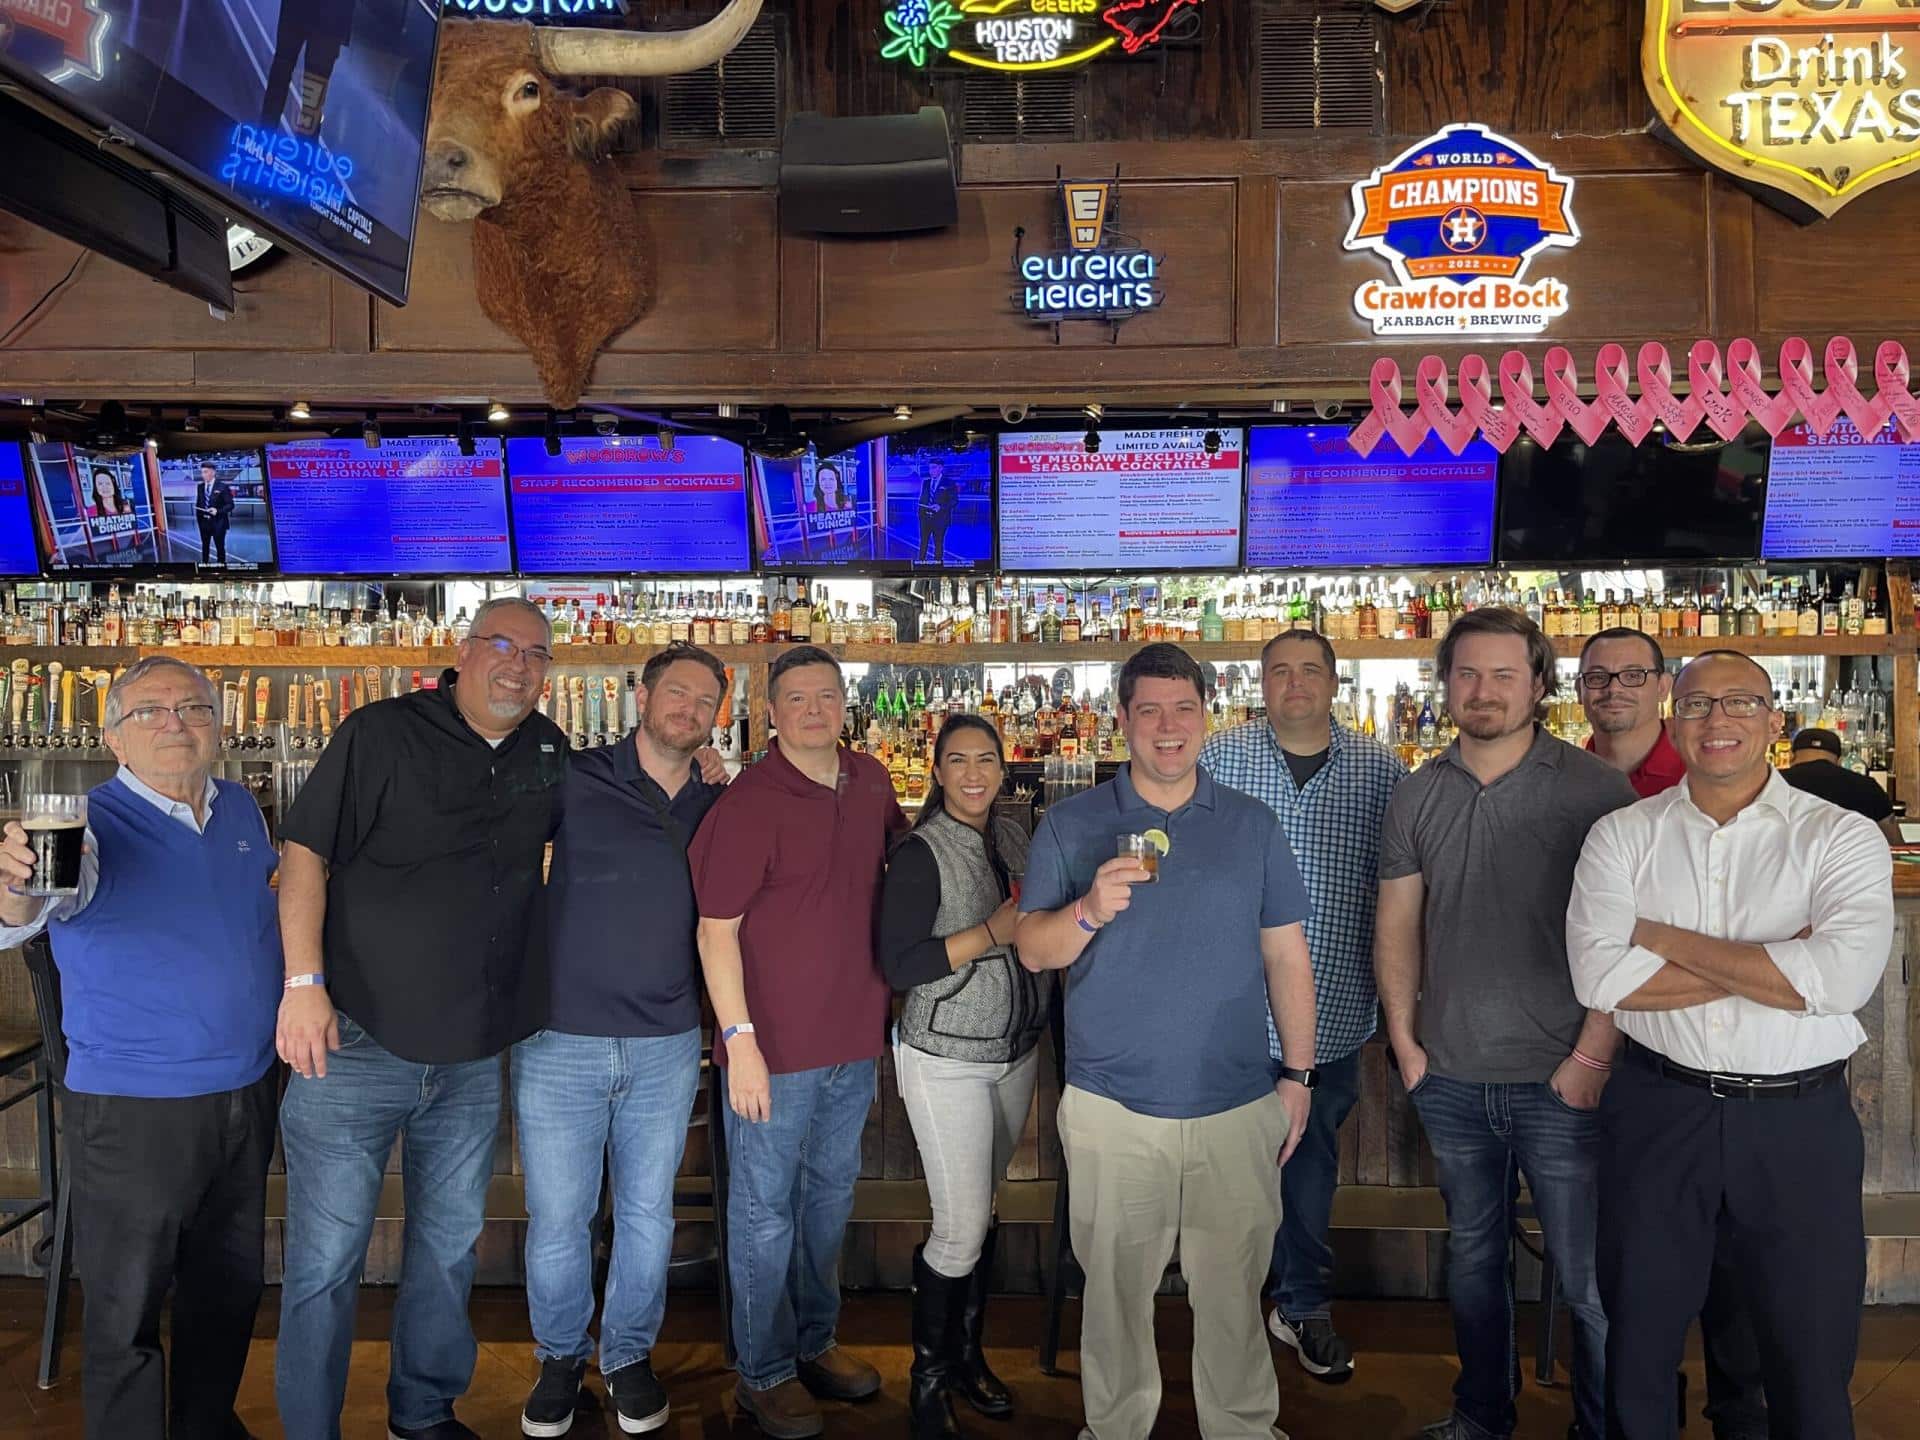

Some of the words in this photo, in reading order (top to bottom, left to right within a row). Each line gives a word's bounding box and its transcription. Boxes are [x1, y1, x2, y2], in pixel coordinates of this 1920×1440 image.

[976, 18, 1073, 44] HOUSTON
[994, 39, 1059, 62] TEXAS
[1747, 32, 1907, 85] Drink
[1725, 89, 1920, 142] TEXAS
[1436, 153, 1493, 165] WORLD
[1389, 177, 1538, 209] CHAMPIONS
[1450, 217, 1477, 243] H
[1022, 254, 1153, 281] eureka
[1448, 260, 1480, 268] 2022
[1363, 284, 1486, 310] Crawford
[1494, 283, 1561, 309] Bock
[1383, 315, 1455, 327] KARBACH
[1470, 314, 1542, 326] BREWING
[1124, 431, 1157, 439] MADE
[1159, 430, 1193, 439] FRESH
[386, 439, 417, 447] MADE
[1116, 442, 1159, 450] LIMITED
[1162, 441, 1238, 449] AVAILAITY
[380, 450, 421, 458] LIMITED
[1019, 455, 1042, 464] LW
[1048, 454, 1128, 464] MIDTOWN
[1134, 452, 1223, 462] EXCLUSIVE
[287, 461, 309, 470] LW
[316, 460, 393, 470] MIDTOWN
[1031, 463, 1114, 472] SEASONAL
[1120, 460, 1210, 470] COCKTAILS
[300, 469, 380, 478] SEASONAL
[1304, 467, 1407, 479] RECOMMENDED
[1411, 466, 1486, 476] COCKTAILS
[520, 479, 559, 488] STAFF
[562, 478, 660, 487] RECOMMENDED
[663, 477, 736, 486] COCKTAILS
[90, 514, 136, 527] HEATHER
[809, 511, 856, 523] HEATHER
[100, 523, 132, 534] DINICH
[817, 519, 851, 530] DINICH
